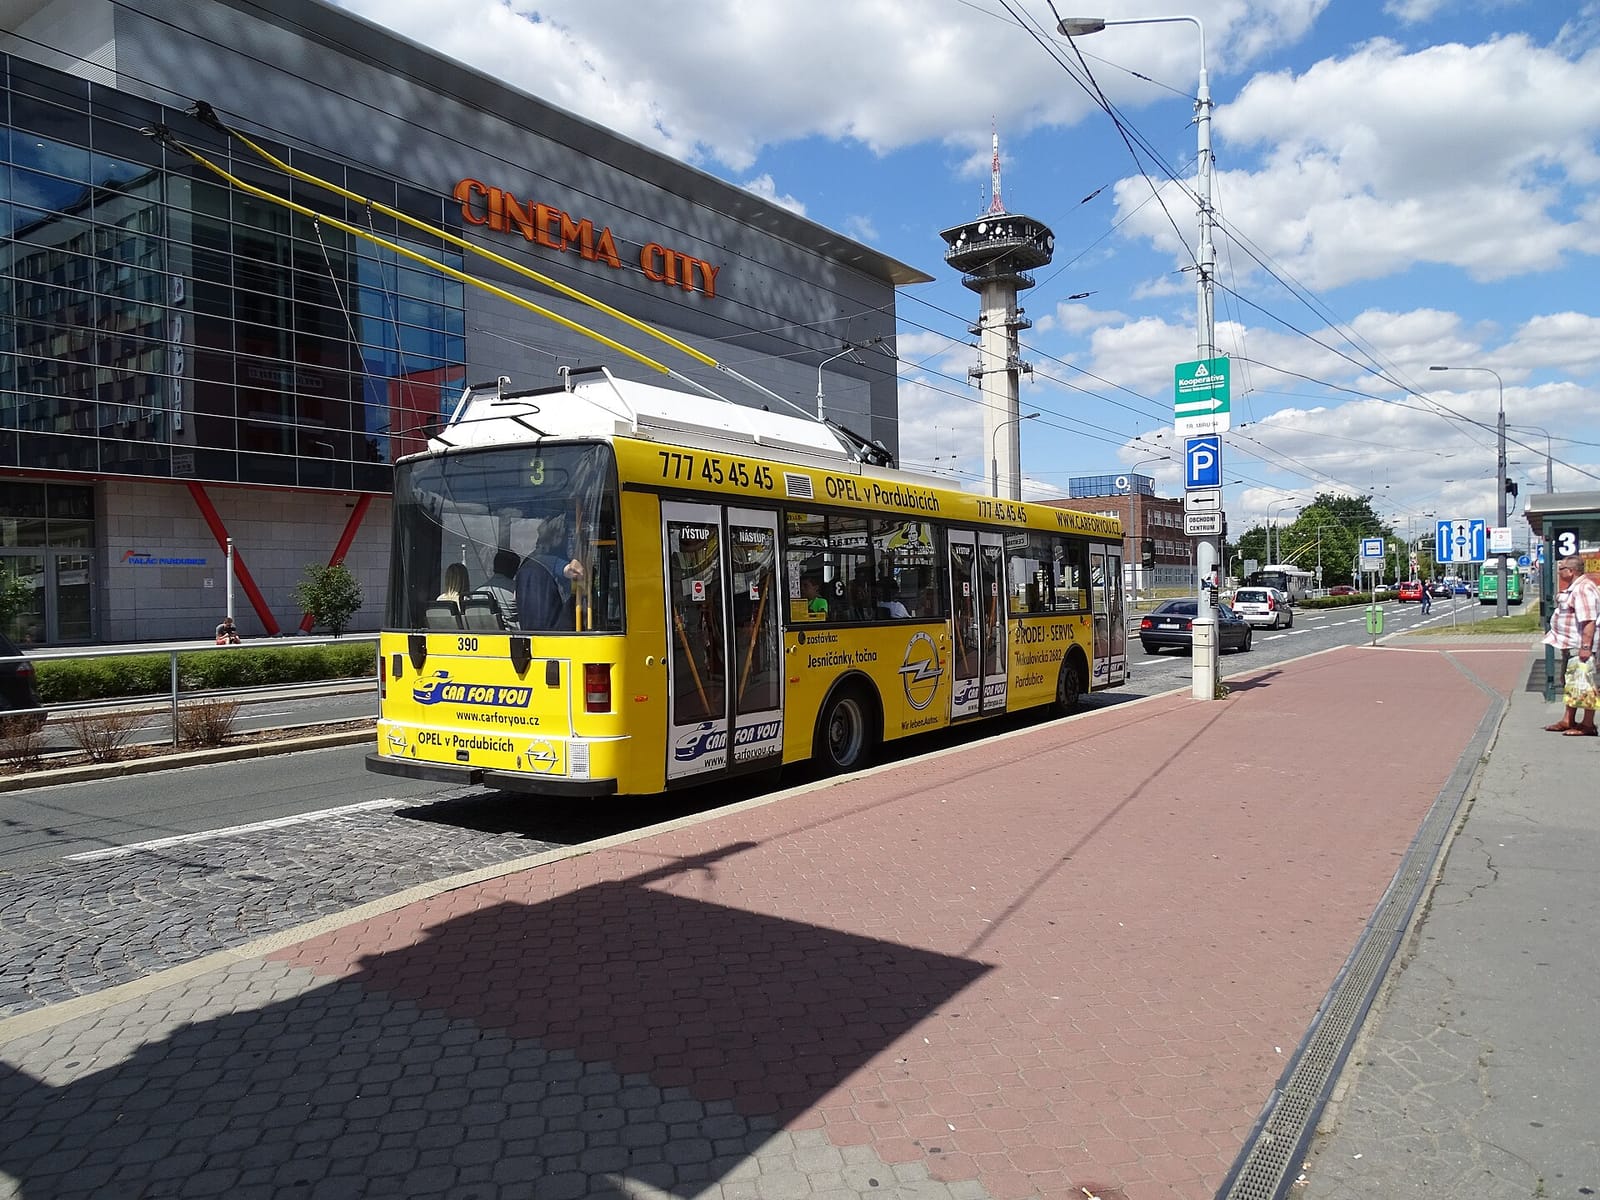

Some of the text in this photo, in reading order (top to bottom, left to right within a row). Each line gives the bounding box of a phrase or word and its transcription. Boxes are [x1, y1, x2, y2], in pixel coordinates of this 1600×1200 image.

[453, 177, 720, 298] CINEMA CITY
[1178, 375, 1225, 387] Kooperativa
[530, 458, 544, 485] 3
[659, 452, 773, 490] 777 45 45 45
[1193, 451, 1214, 480] P
[825, 476, 940, 511] OPEL v Pardubicích
[976, 500, 1027, 523] 777 45 45 45
[1055, 512, 1120, 535] WWW.CARFORYOU.CZ
[739, 529, 766, 544] NÁSTUP
[1558, 532, 1577, 556] 3
[807, 633, 838, 644] zastávka:
[1051, 623, 1074, 641] SERVIS
[457, 637, 478, 651] 390
[856, 648, 877, 662] točna
[1015, 672, 1044, 688] Pardubice
[441, 685, 528, 706] CAR FOR YOU
[456, 711, 540, 726] www.carforyou.cz
[418, 732, 514, 752] OPEL v Pardubicích
[705, 722, 778, 750] CAR FOR YOU
